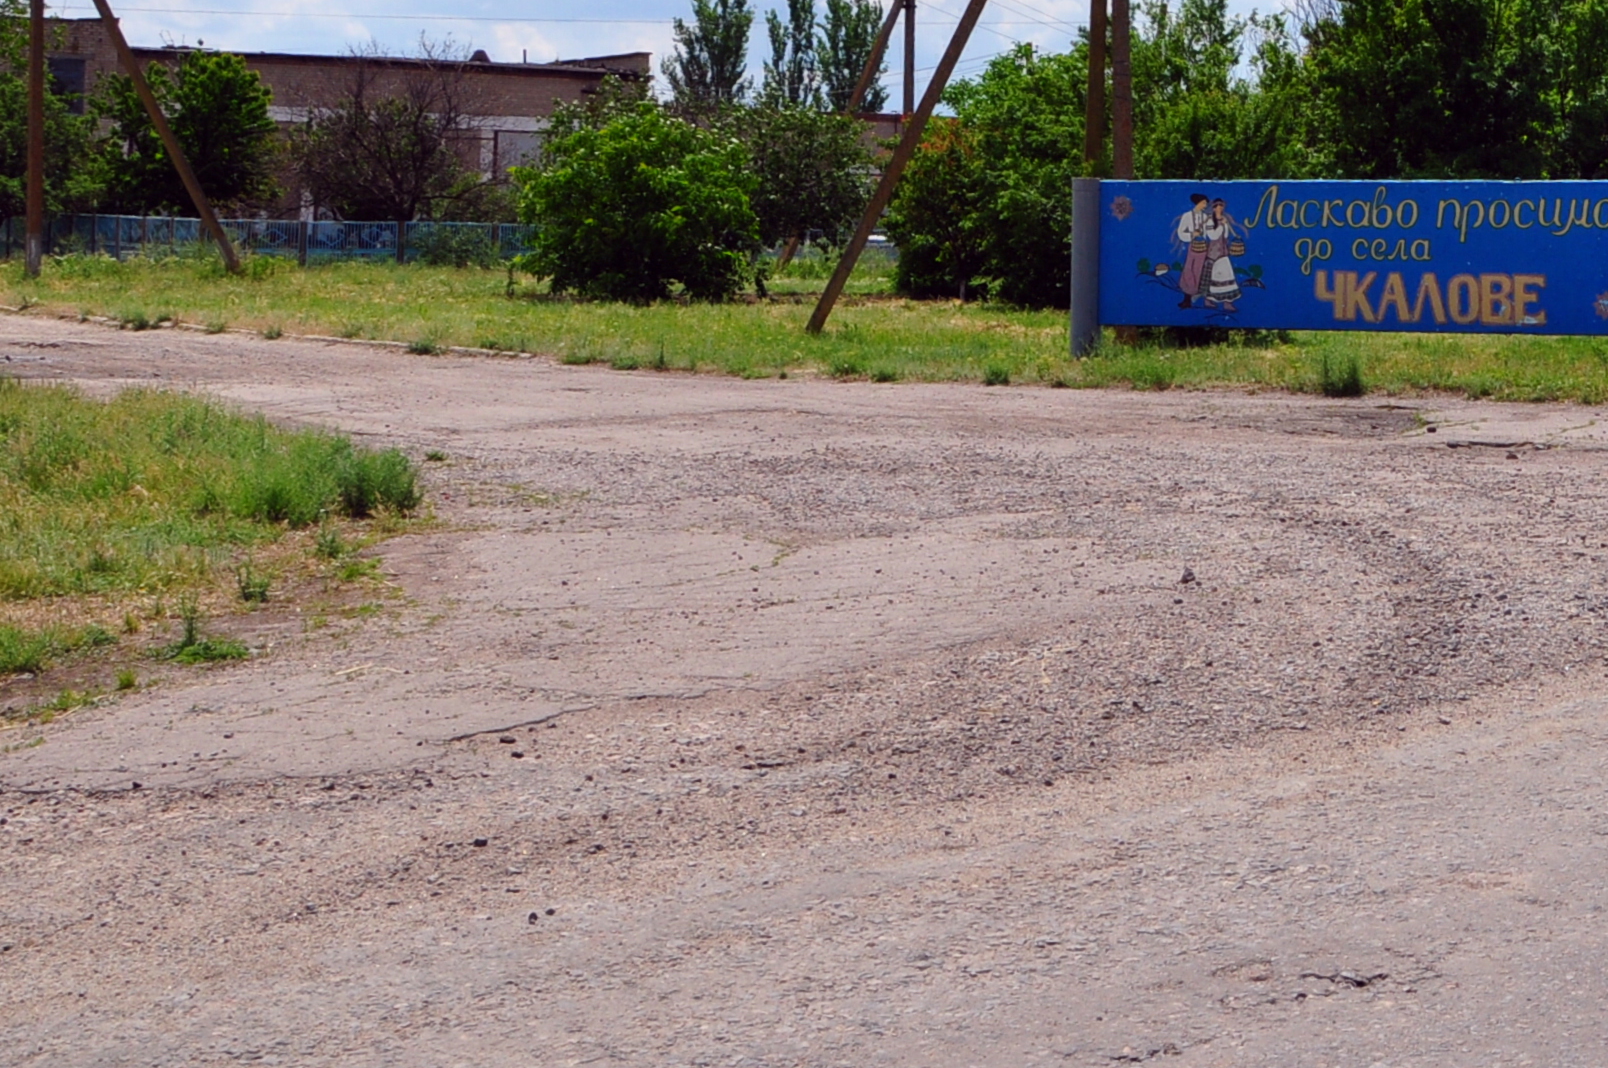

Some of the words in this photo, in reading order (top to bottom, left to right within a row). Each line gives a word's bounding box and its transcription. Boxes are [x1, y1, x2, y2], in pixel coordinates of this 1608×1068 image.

[1243, 184, 1419, 229] Ласкаво
[1294, 237, 1333, 276] до
[1352, 238, 1431, 261] села
[1314, 269, 1545, 325] ЧКАЛОВЕ
